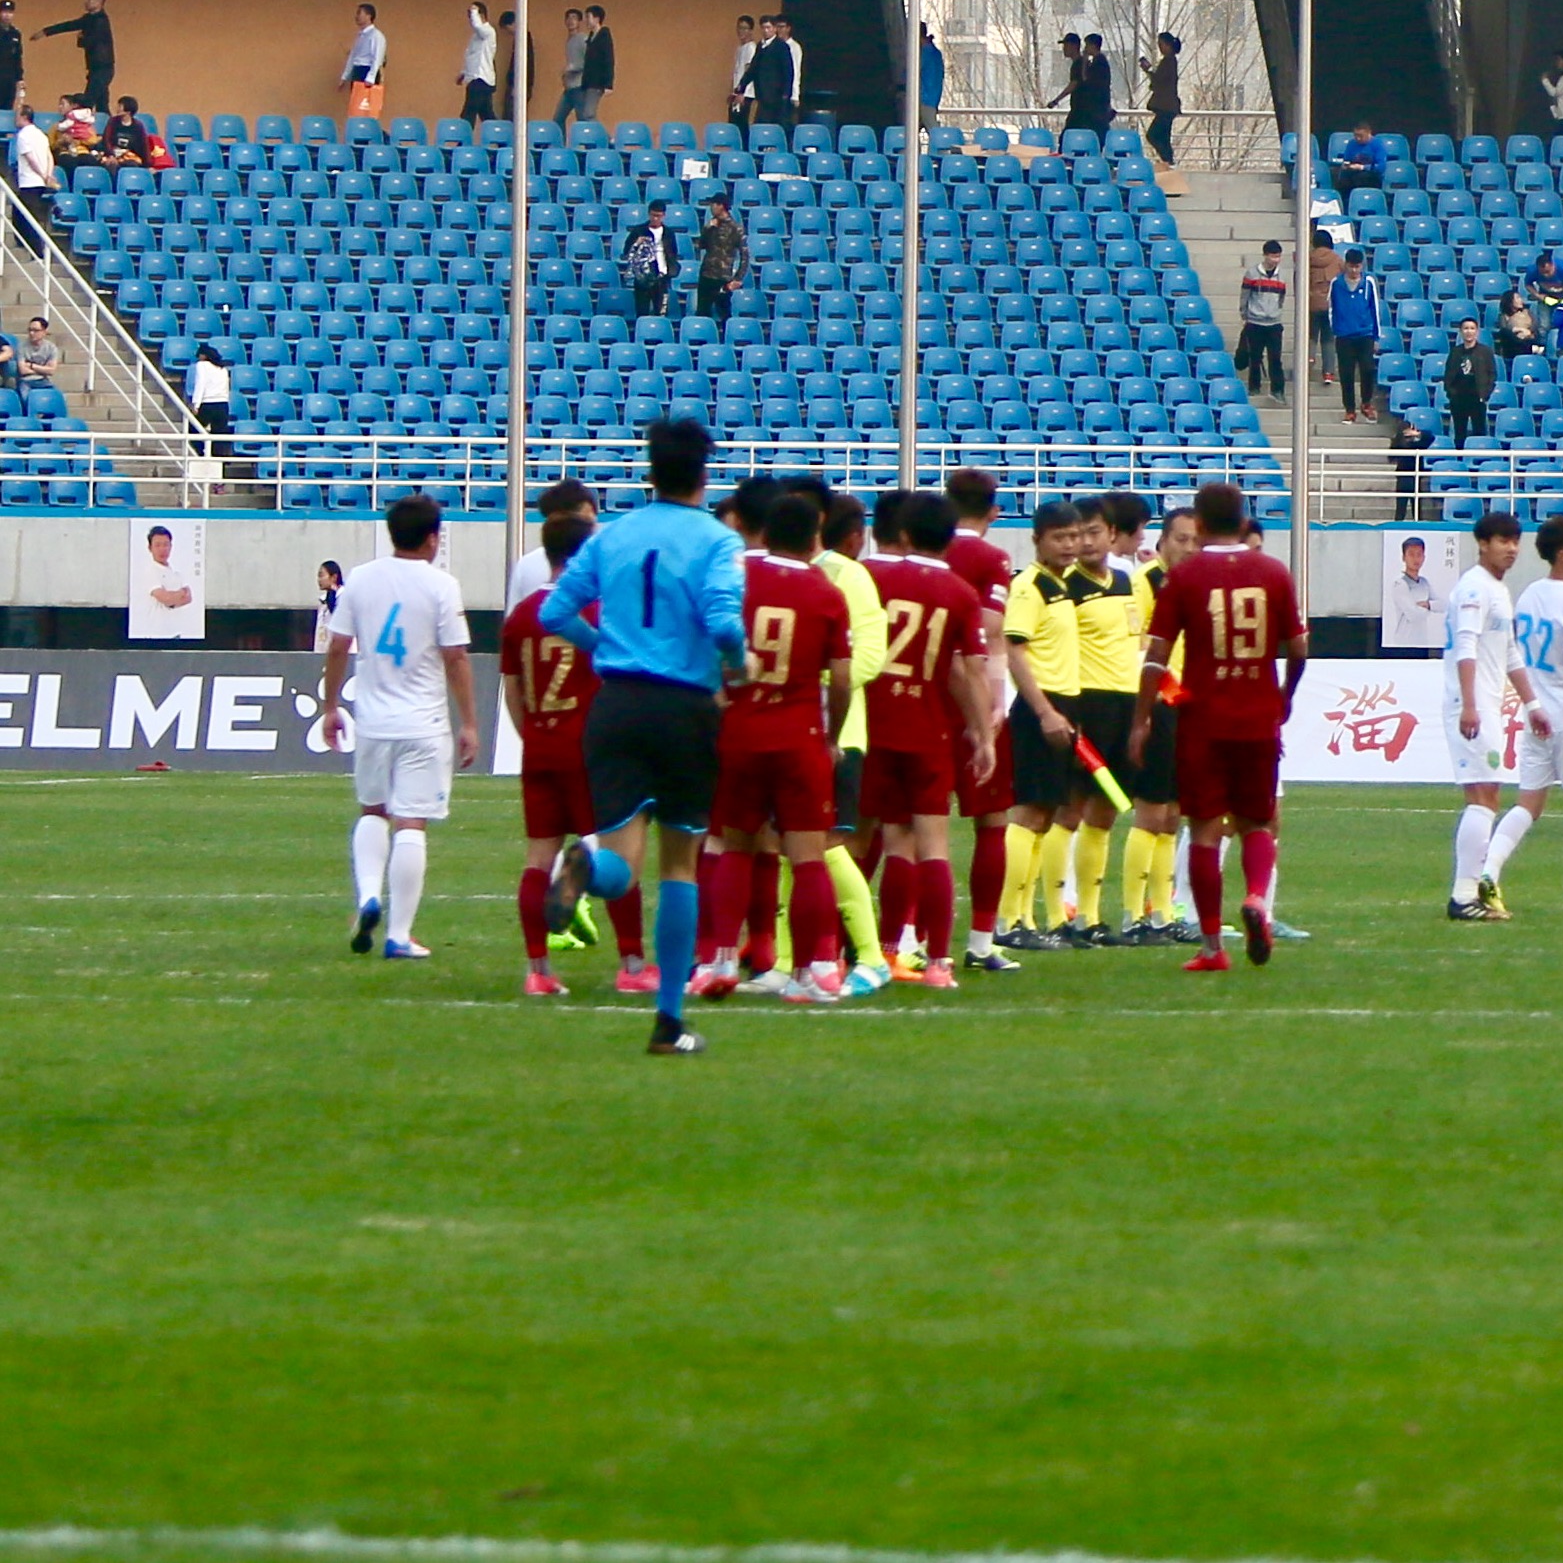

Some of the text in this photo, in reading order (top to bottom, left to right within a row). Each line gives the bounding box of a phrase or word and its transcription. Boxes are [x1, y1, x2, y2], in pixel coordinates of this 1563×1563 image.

[640, 549, 659, 628] 1
[1207, 586, 1267, 659] 19
[374, 602, 408, 668] 4
[520, 635, 579, 713] 12
[880, 598, 949, 681] 21
